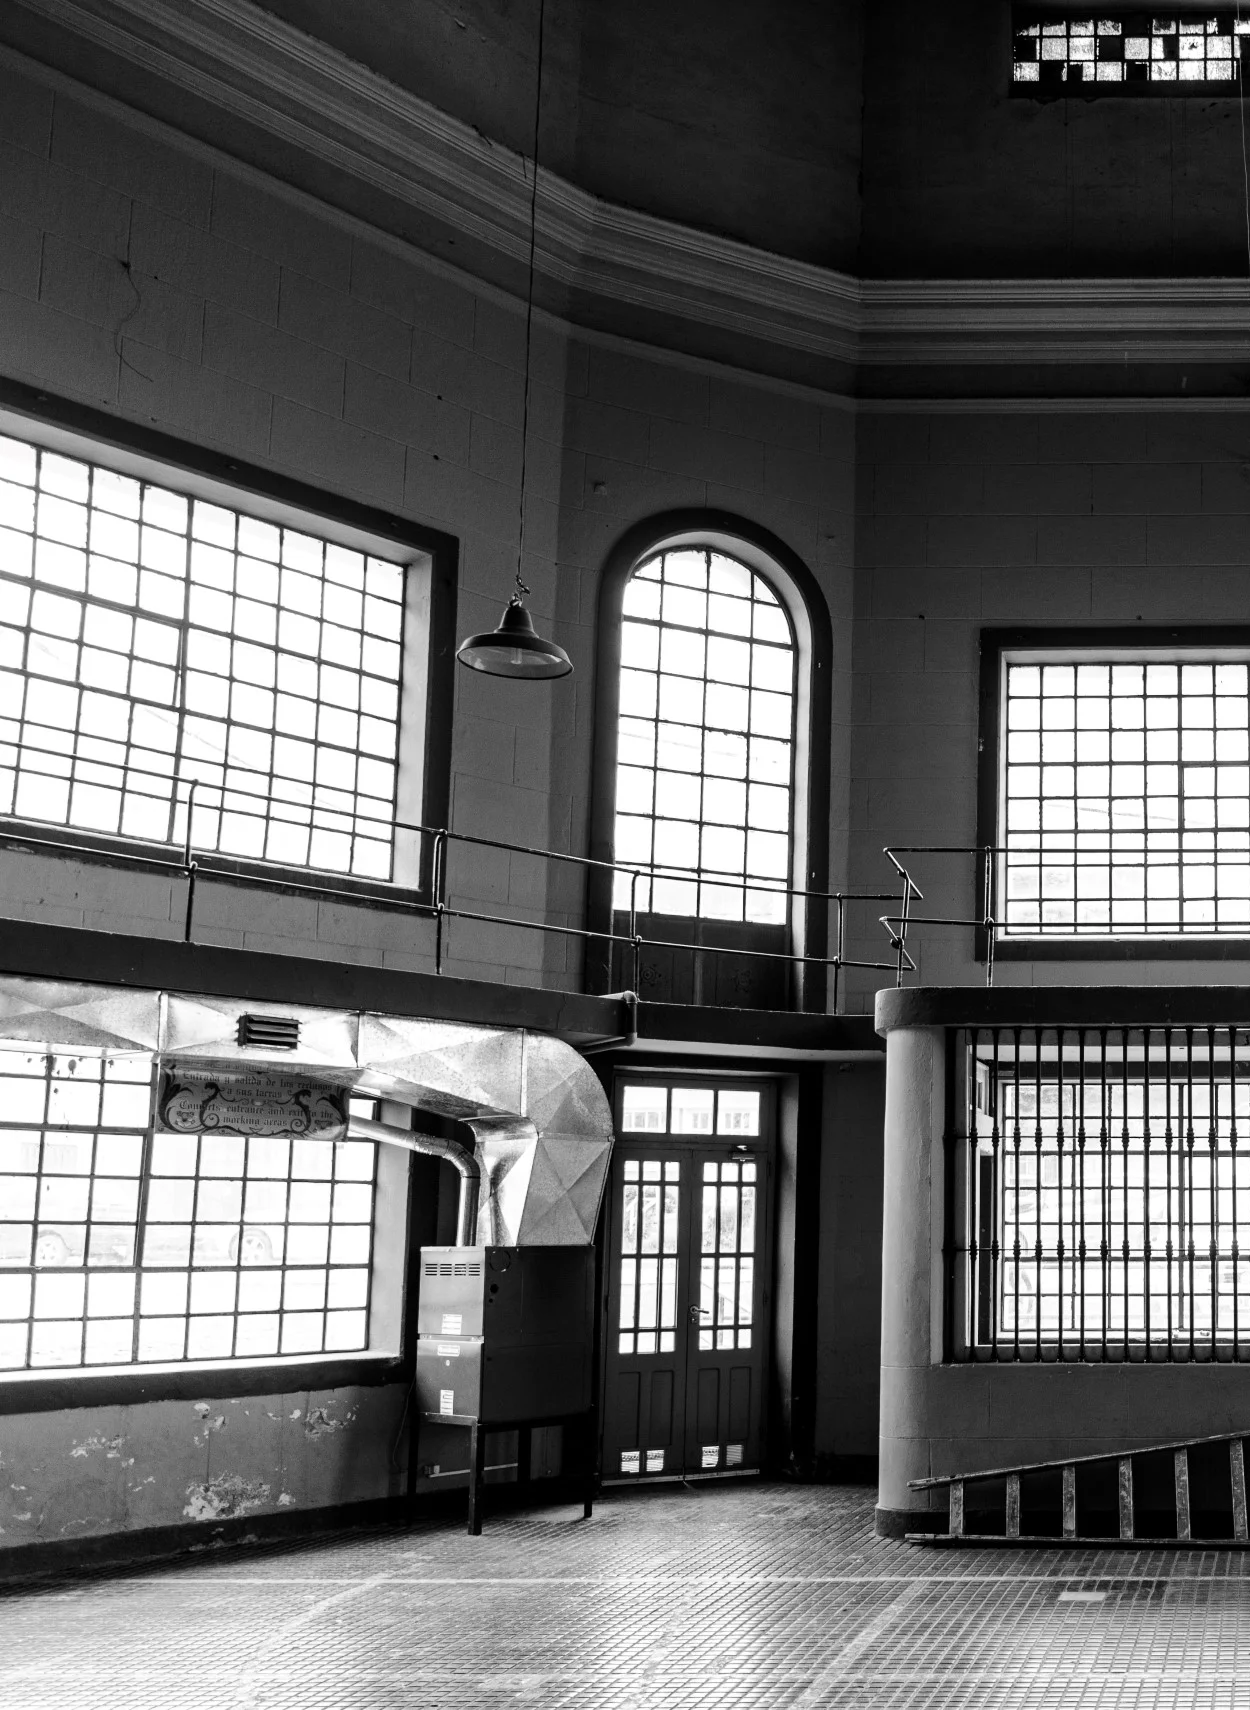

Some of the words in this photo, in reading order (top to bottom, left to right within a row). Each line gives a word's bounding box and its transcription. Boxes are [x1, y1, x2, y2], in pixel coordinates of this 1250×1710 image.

[183, 1072, 220, 1082] Entrada
[224, 1076, 230, 1084] y
[234, 1075, 262, 1086] salida
[266, 1077, 276, 1086] de
[280, 1078, 294, 1088] los
[297, 1081, 333, 1091] reclusos
[236, 1089, 252, 1097] sus
[227, 1105, 264, 1114] entrance
[268, 1106, 285, 1115] and
[289, 1109, 303, 1117] exit
[320, 1110, 334, 1119] the
[223, 1115, 260, 1126] working
[264, 1118, 287, 1126] areas
